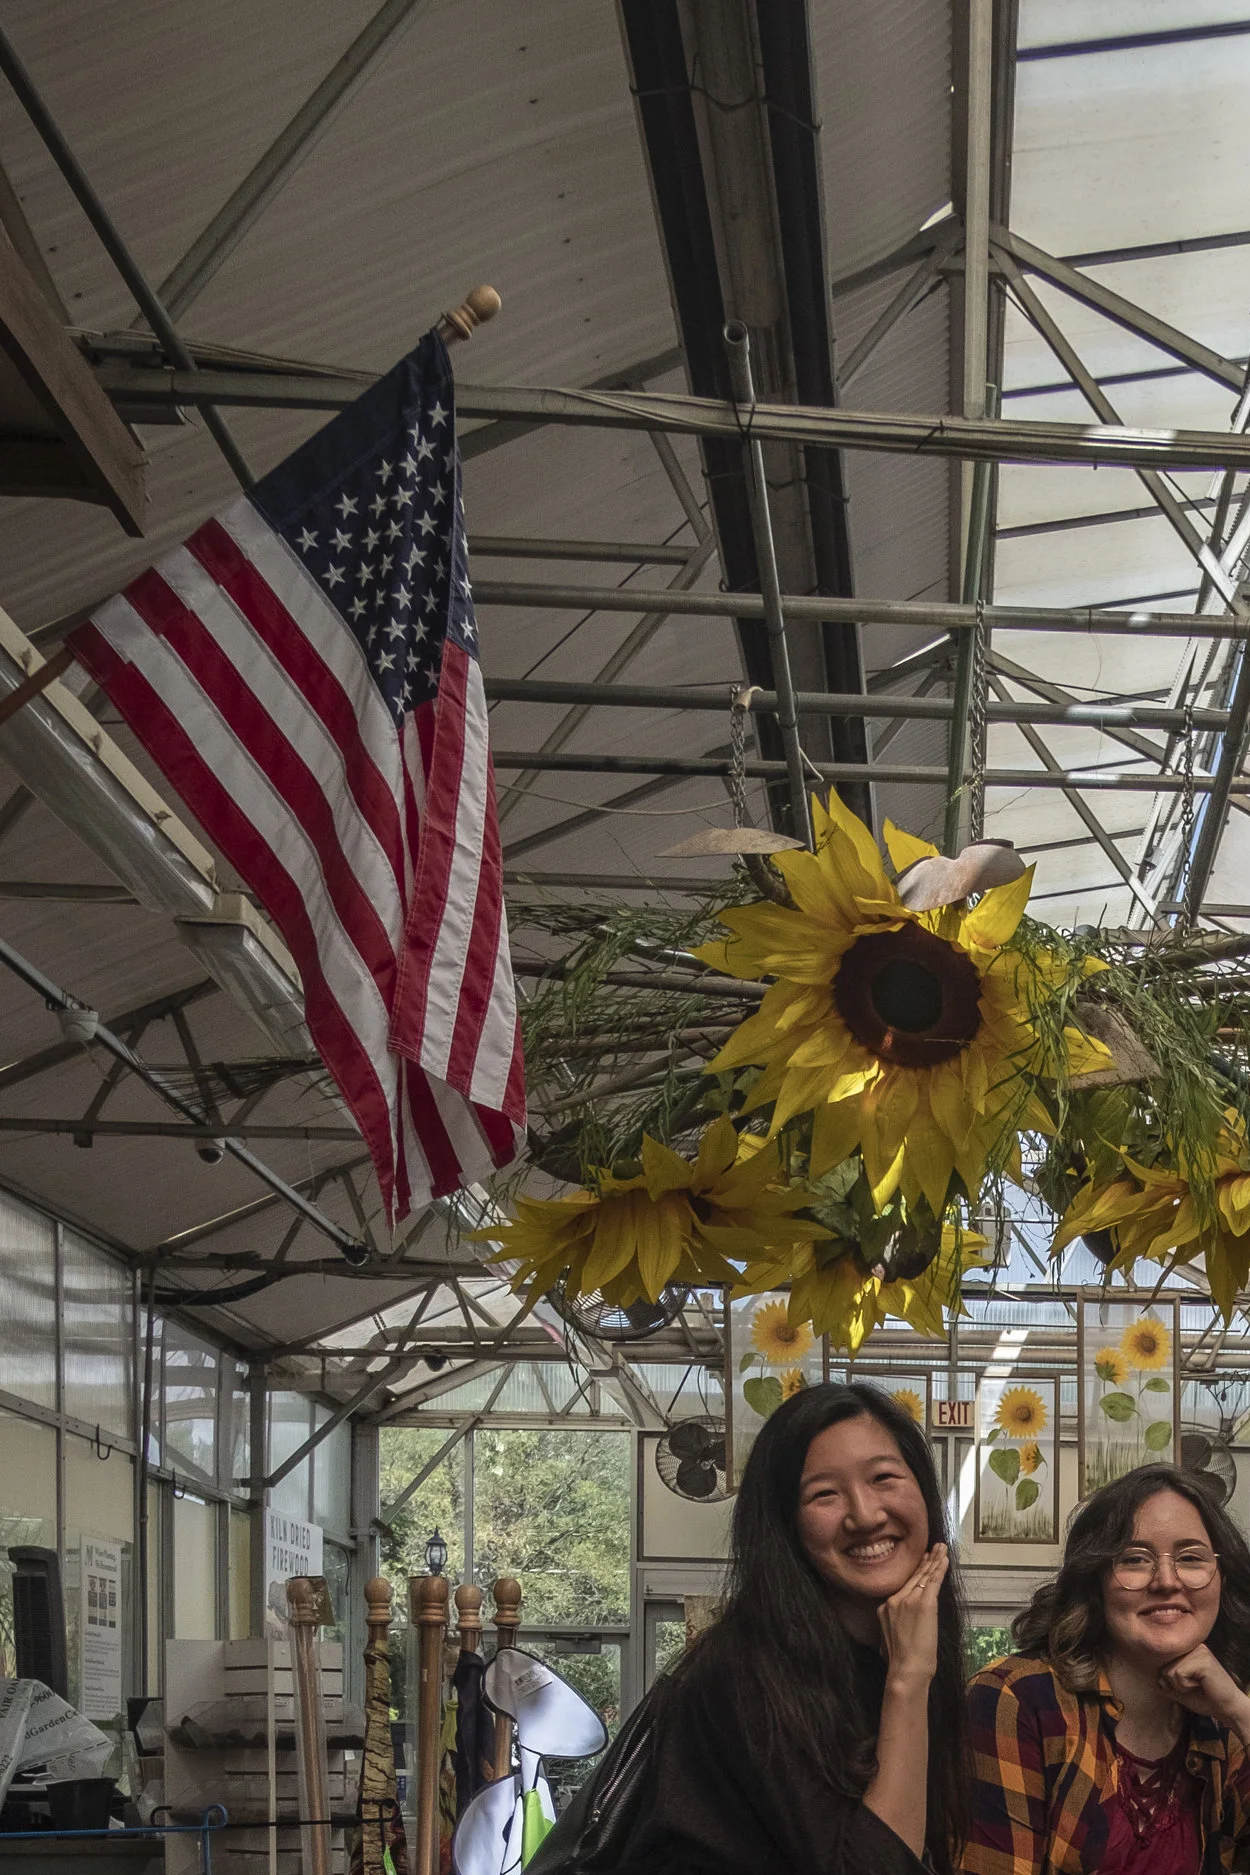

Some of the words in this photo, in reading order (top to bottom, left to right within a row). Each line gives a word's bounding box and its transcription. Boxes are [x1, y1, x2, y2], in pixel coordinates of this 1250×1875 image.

[938, 1402, 970, 1425] EXIT
[271, 1515, 288, 1544] KILN
[290, 1522, 311, 1551] DRIED
[273, 1546, 309, 1577] FIREWOOD
[0, 1696, 14, 1719] FAIR
